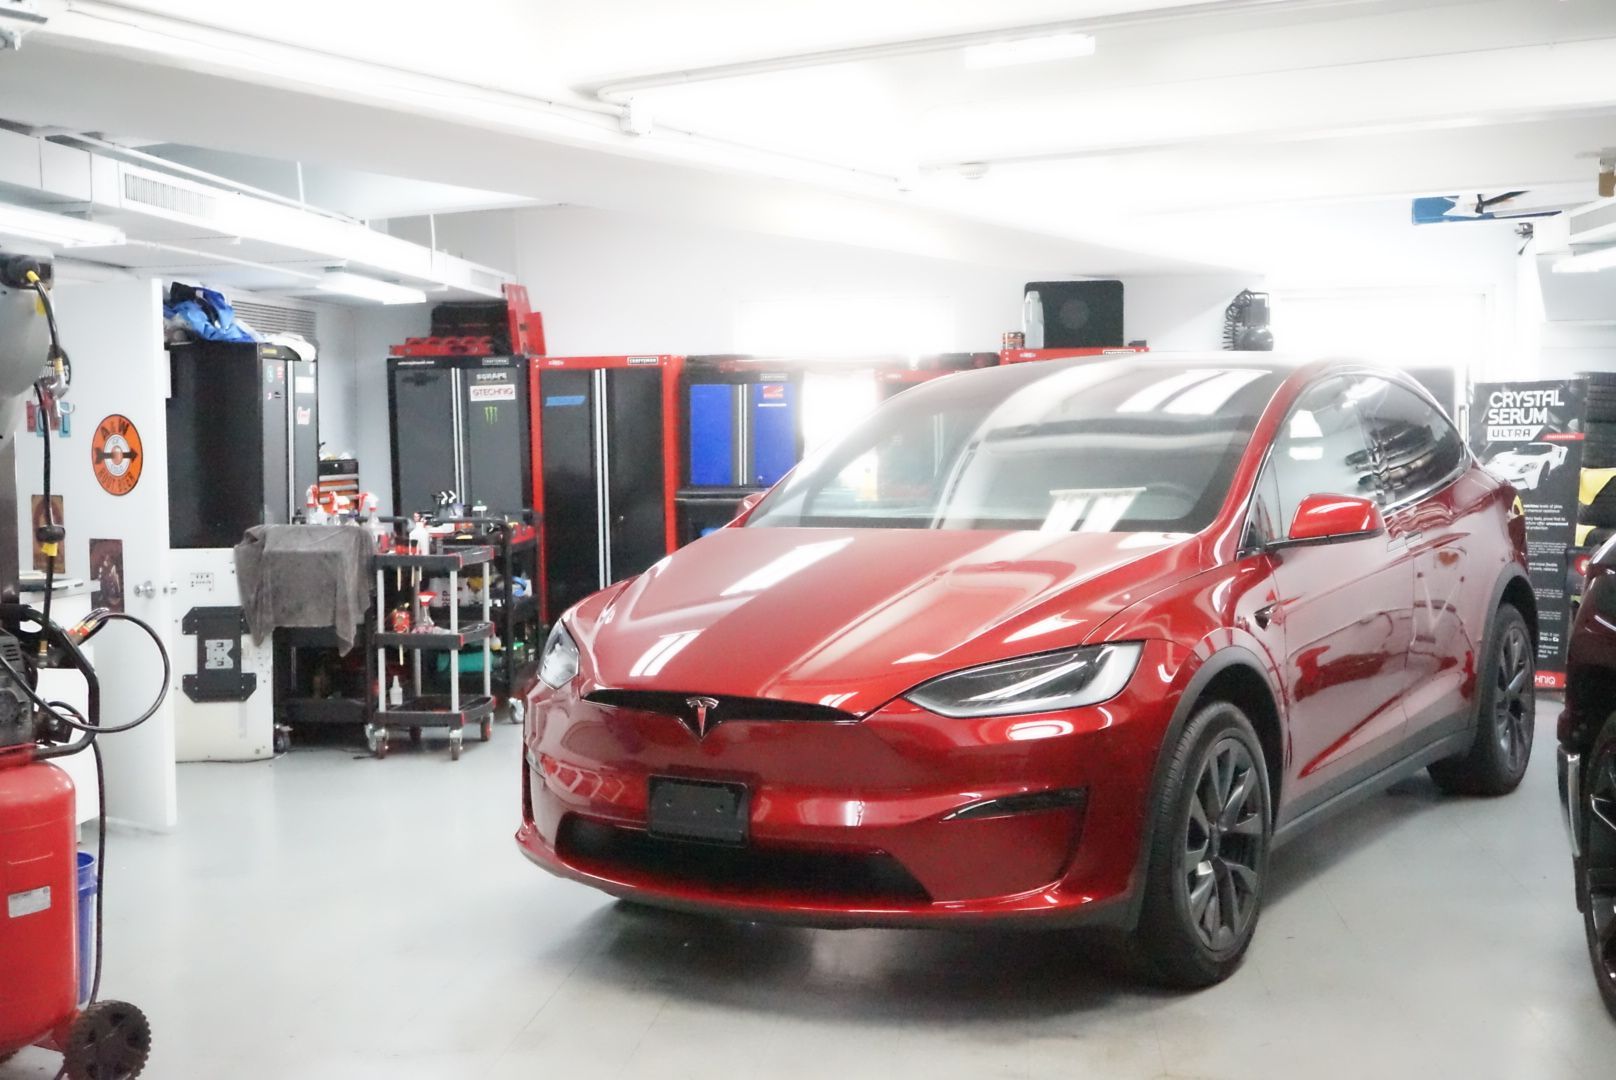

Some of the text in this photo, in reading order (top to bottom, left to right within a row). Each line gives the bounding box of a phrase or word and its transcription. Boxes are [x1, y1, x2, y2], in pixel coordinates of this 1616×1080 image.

[1489, 389, 1565, 408] CRYSTAL
[1487, 407, 1548, 425] SERUM
[1492, 428, 1531, 438] ULTRA
[1534, 674, 1556, 685] HNIQ
